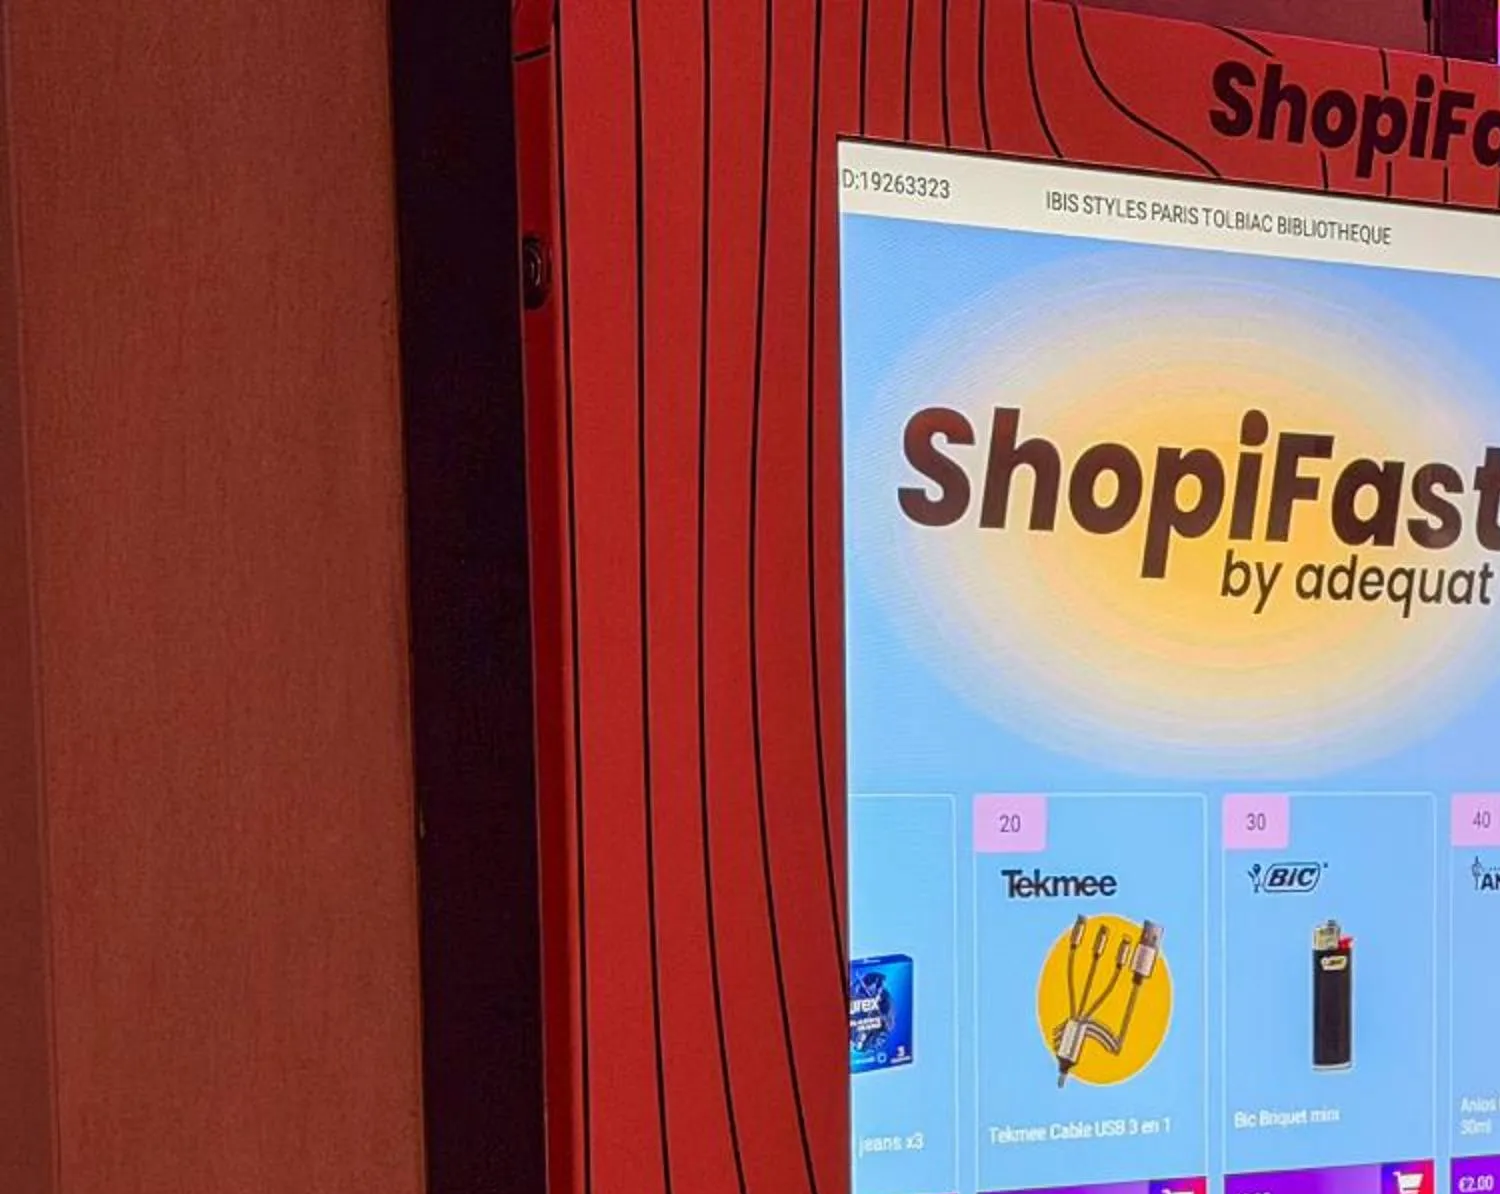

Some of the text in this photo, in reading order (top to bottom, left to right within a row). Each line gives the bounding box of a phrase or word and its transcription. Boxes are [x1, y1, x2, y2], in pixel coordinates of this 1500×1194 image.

[1046, 191, 1392, 245] IBIS STYLES PARIS TOLBIAC BIBLIOTHEQUE
[1220, 549, 1494, 618] by adequat
[1000, 814, 1021, 833] 20
[1247, 812, 1267, 831] 30
[1472, 810, 1491, 829] 40
[1001, 868, 1118, 898] Tekmee
[1267, 867, 1318, 887] BIC
[1460, 1096, 1497, 1113] Anios
[1234, 1107, 1340, 1128] Bic Briquet mini
[989, 1116, 1171, 1144] Tekmee Cable USB 3 en 1
[1458, 1175, 1494, 1193] €2.00
